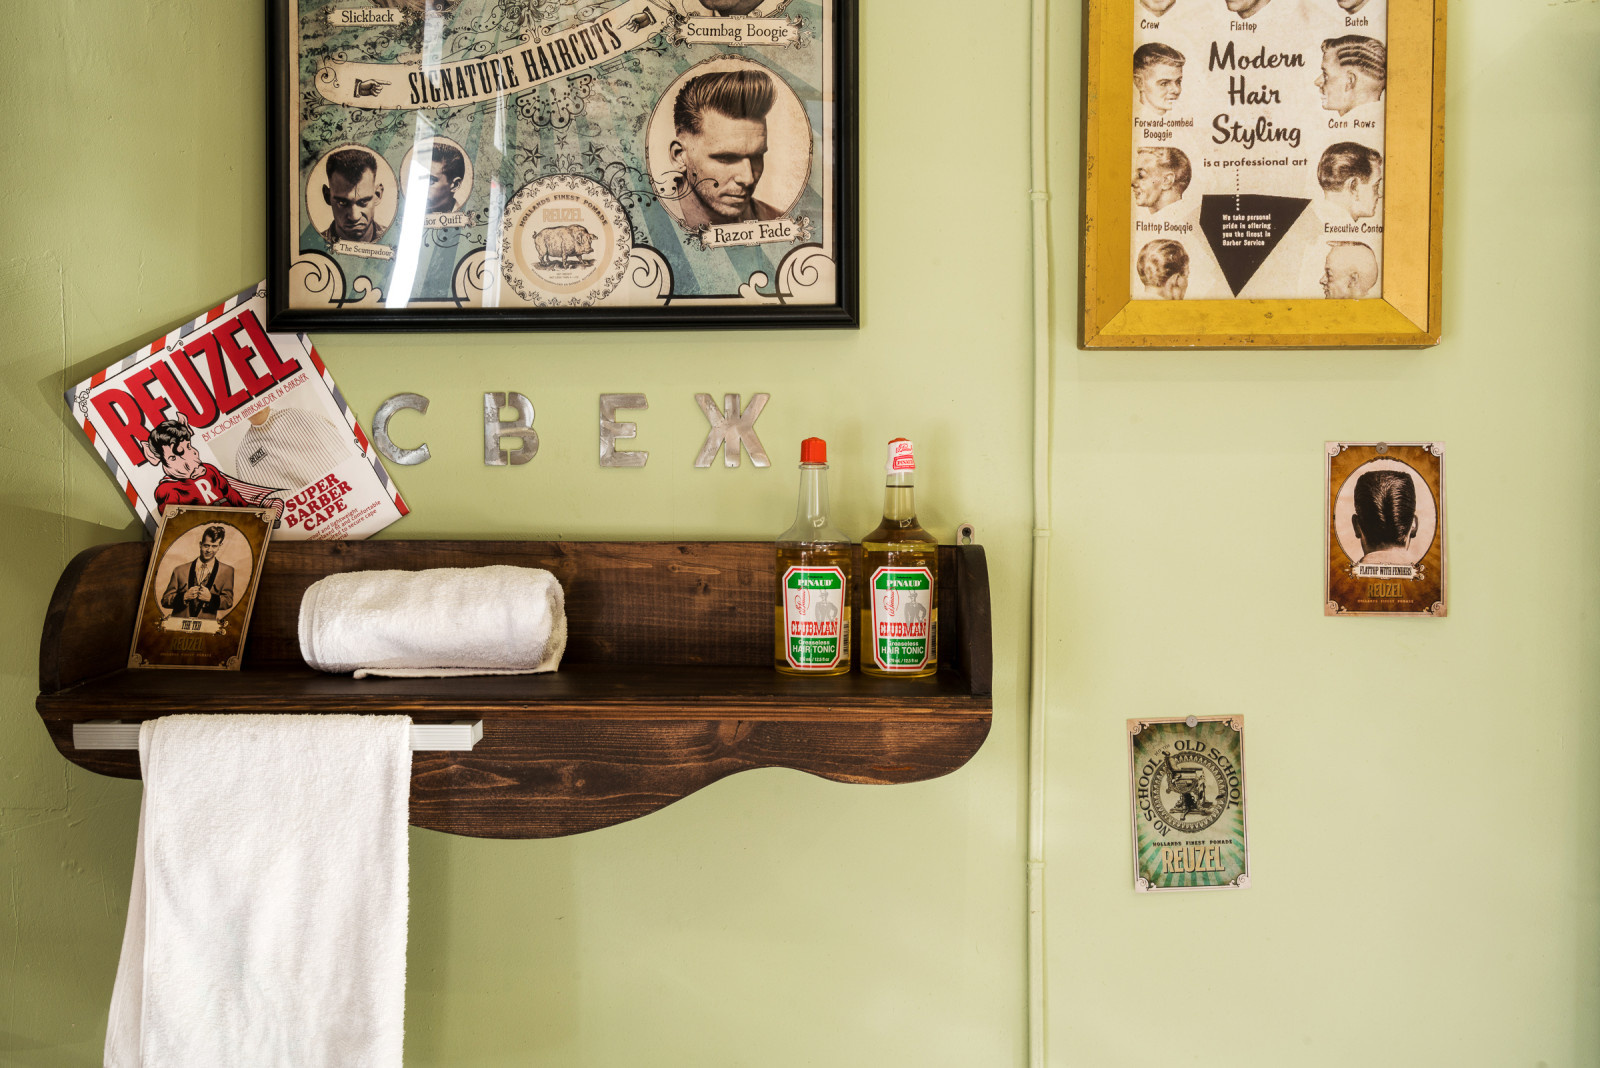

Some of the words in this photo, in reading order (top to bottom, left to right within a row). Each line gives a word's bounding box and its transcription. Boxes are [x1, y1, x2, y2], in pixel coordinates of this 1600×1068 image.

[341, 10, 394, 24] Slickback
[1140, 20, 1160, 30] Crew
[1345, 16, 1368, 27] Butch
[687, 23, 742, 41] Scumbag
[747, 24, 788, 41] Boogie
[1230, 21, 1258, 33] Flattop
[408, 54, 520, 104] SIGNATURE
[521, 18, 622, 82] HAIRCUTS
[1208, 40, 1306, 72] Modern
[1228, 76, 1281, 106] Hair
[1134, 117, 1194, 127] Forward-combed
[1328, 118, 1348, 128] Corn
[1354, 119, 1376, 128] Rows
[1212, 114, 1302, 150] Styling
[1204, 158, 1211, 167] is
[1223, 157, 1288, 168] professional
[439, 214, 462, 226] Quiff
[520, 198, 550, 227] HOLLANDS
[583, 200, 608, 226] POMADE
[543, 208, 584, 222] REUZEL
[714, 228, 753, 242] Razor
[759, 224, 790, 238] Fade
[1136, 221, 1162, 234] Flattop
[1325, 222, 1359, 233] Executive
[340, 243, 353, 252] The
[90, 308, 302, 467] REUZEL
[211, 414, 242, 436] SCHOREM
[283, 373, 309, 393] BARBIER
[194, 479, 218, 505] R
[285, 473, 340, 512] SUPER
[284, 481, 352, 528] BARBER
[351, 500, 381, 521] comfortable
[304, 498, 347, 531] CAPE
[365, 509, 376, 519] cape
[1368, 583, 1403, 598] REUZEL
[791, 621, 838, 636] CLUBMAN
[880, 621, 926, 637] CLUBMAN
[882, 646, 900, 654] HAIR
[1174, 740, 1206, 752] OLD
[1208, 747, 1241, 810] SCHOOL
[1137, 758, 1162, 822] SCHOOL
[1154, 819, 1171, 837] NO
[1161, 846, 1226, 874] REUZEL
